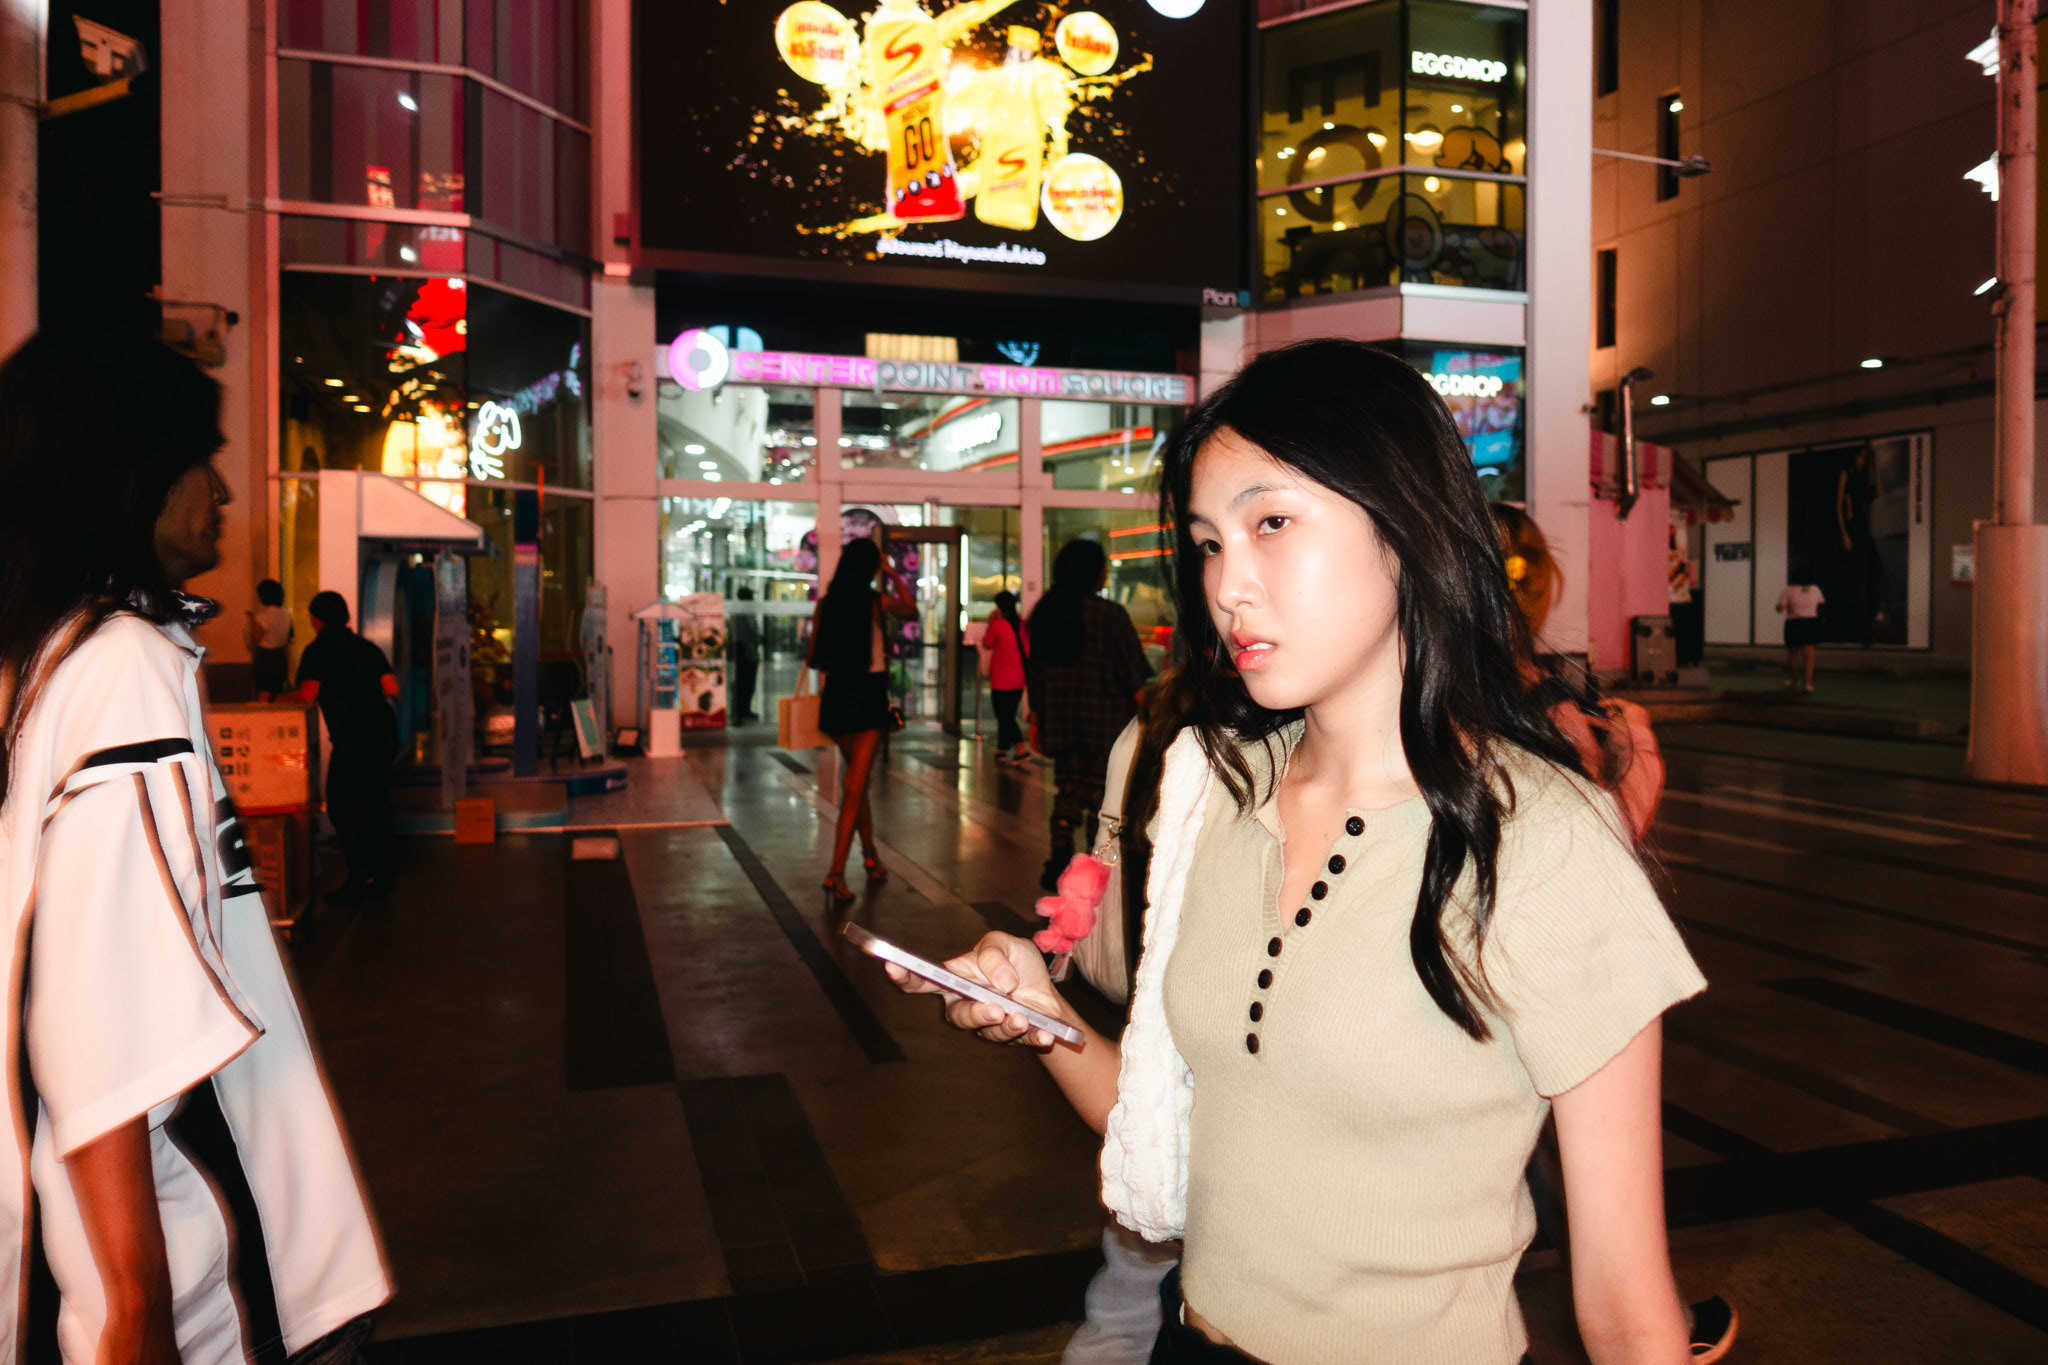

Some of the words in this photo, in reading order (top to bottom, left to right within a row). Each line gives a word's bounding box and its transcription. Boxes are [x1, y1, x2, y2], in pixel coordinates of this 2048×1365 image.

[1411, 51, 1507, 82] EGGDROP
[904, 117, 934, 169] GO
[980, 366, 1059, 393] SIAM
[1062, 373, 1186, 401] SQUARE
[1421, 373, 1503, 398] GDROP
